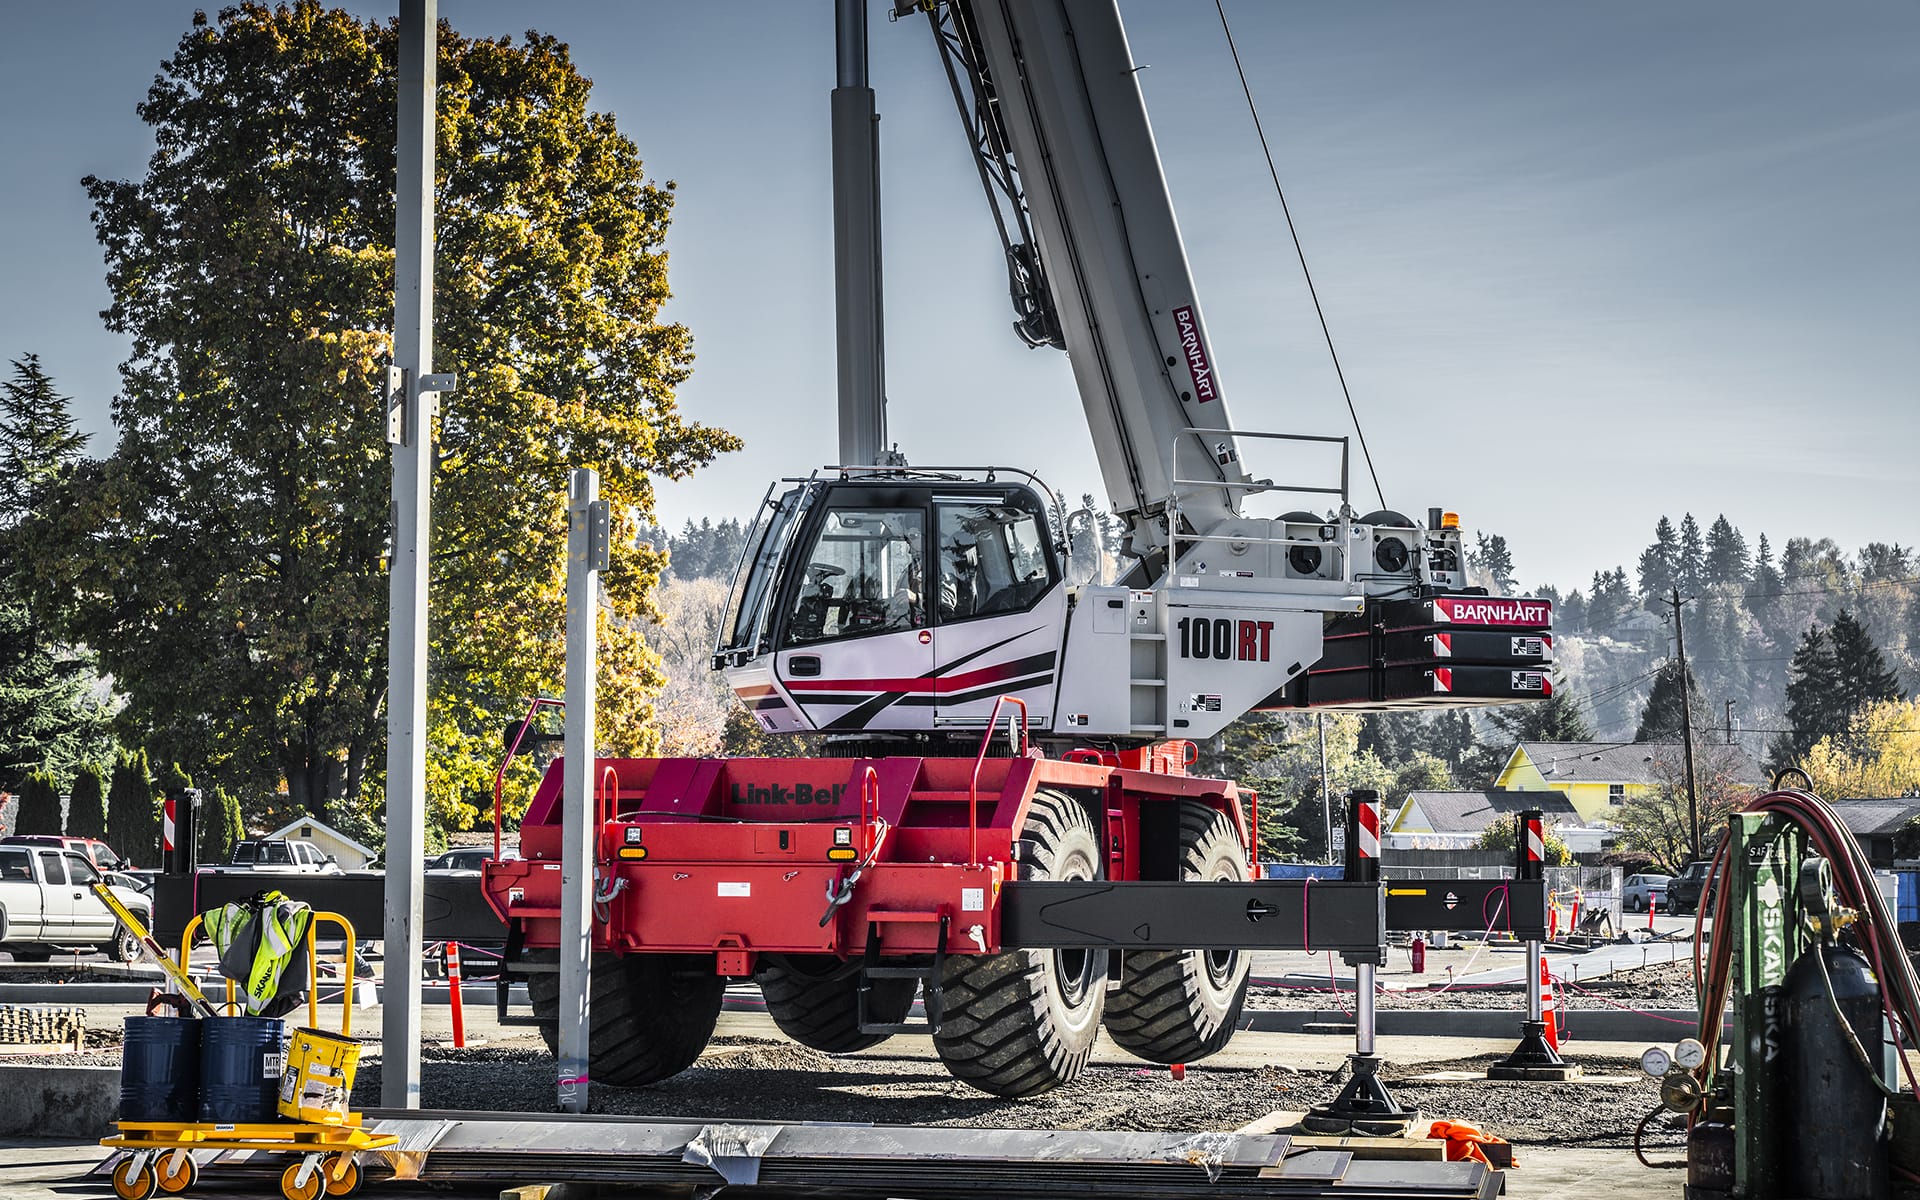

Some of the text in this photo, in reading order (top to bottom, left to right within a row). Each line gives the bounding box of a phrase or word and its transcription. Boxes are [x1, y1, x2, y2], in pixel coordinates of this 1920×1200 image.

[1177, 310, 1213, 398] BARNHART
[1453, 601, 1545, 625] BARNHART
[1334, 835, 1344, 843] 25
